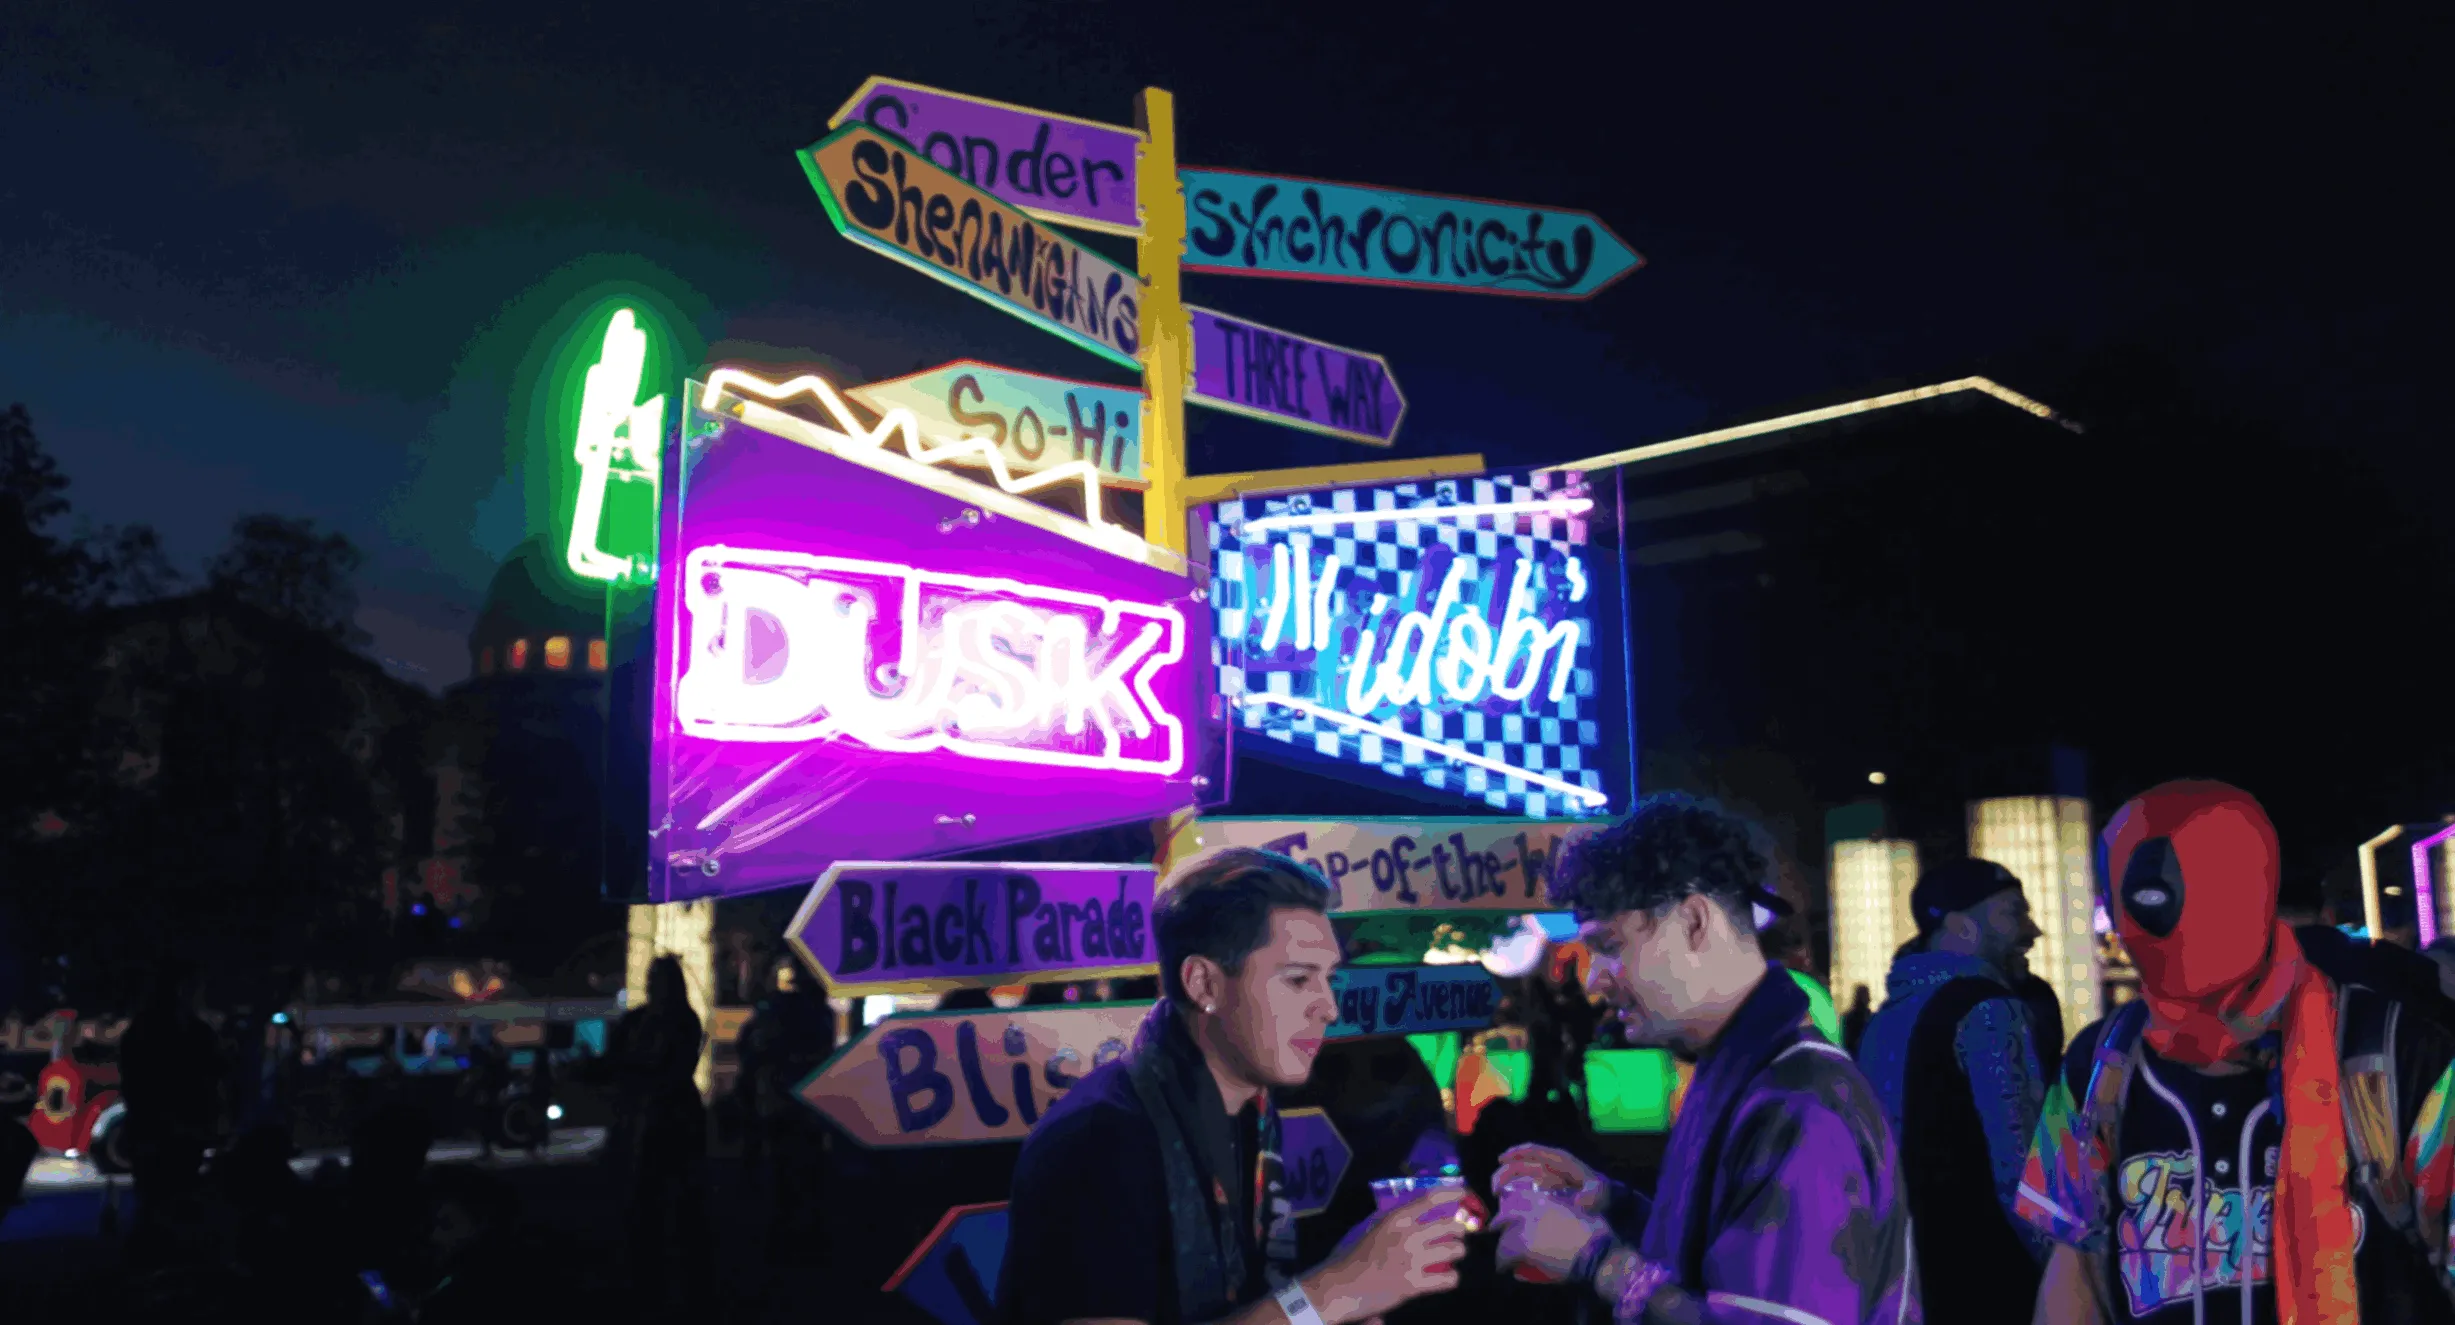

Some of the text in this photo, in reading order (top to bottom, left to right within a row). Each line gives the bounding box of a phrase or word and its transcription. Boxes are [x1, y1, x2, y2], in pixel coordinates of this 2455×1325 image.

[863, 94, 1125, 207] Sonder
[948, 374, 1131, 473] So-Hi
[1213, 318, 1387, 434] THREE WAY
[688, 556, 1170, 755] DUSK
[835, 873, 1146, 975] Black Parade
